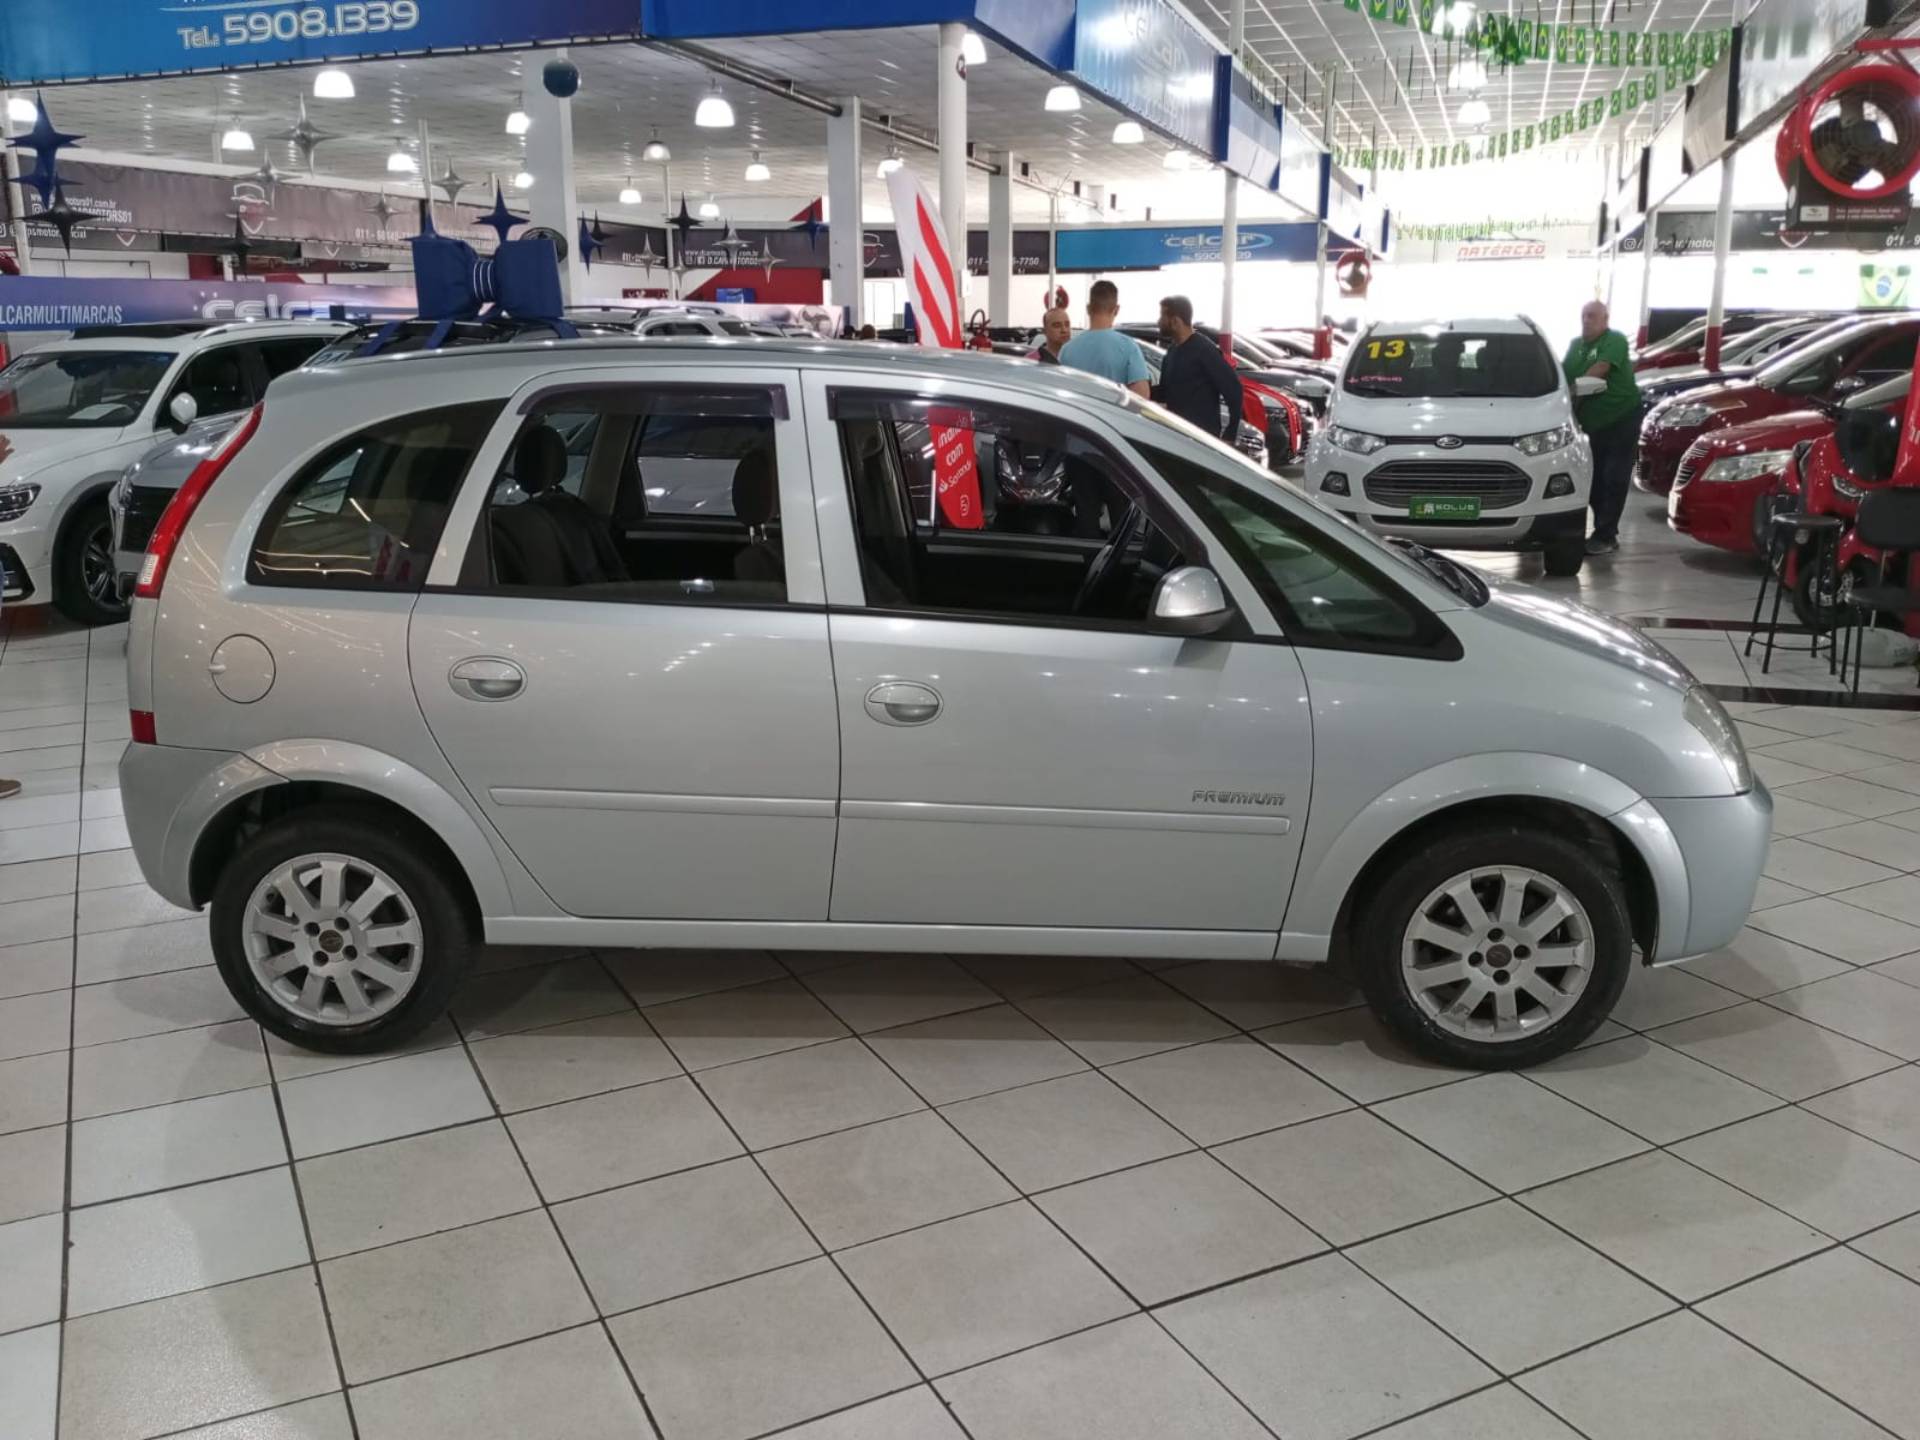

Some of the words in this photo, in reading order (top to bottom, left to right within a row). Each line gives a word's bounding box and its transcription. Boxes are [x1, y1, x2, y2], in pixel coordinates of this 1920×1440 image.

[223, 0, 420, 46] 5908.1339
[1367, 339, 1406, 359] 13
[946, 442, 964, 467] com
